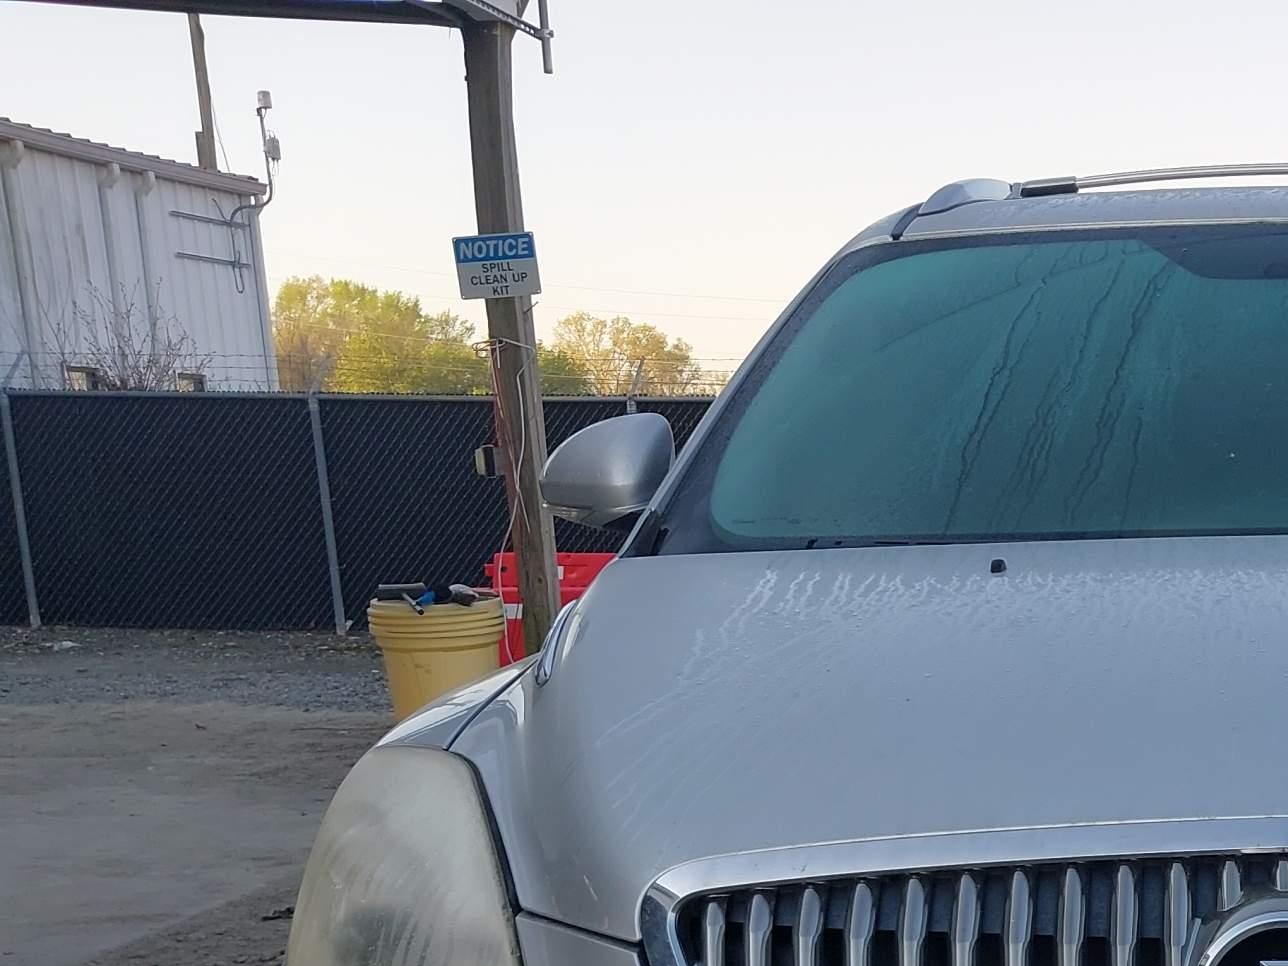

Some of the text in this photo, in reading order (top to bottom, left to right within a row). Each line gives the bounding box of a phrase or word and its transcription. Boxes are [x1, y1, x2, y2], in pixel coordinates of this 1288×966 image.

[460, 237, 529, 259] NOTICE
[481, 261, 514, 273] SPILL
[470, 272, 528, 286] CLEAN UP
[492, 285, 510, 296] KIT
